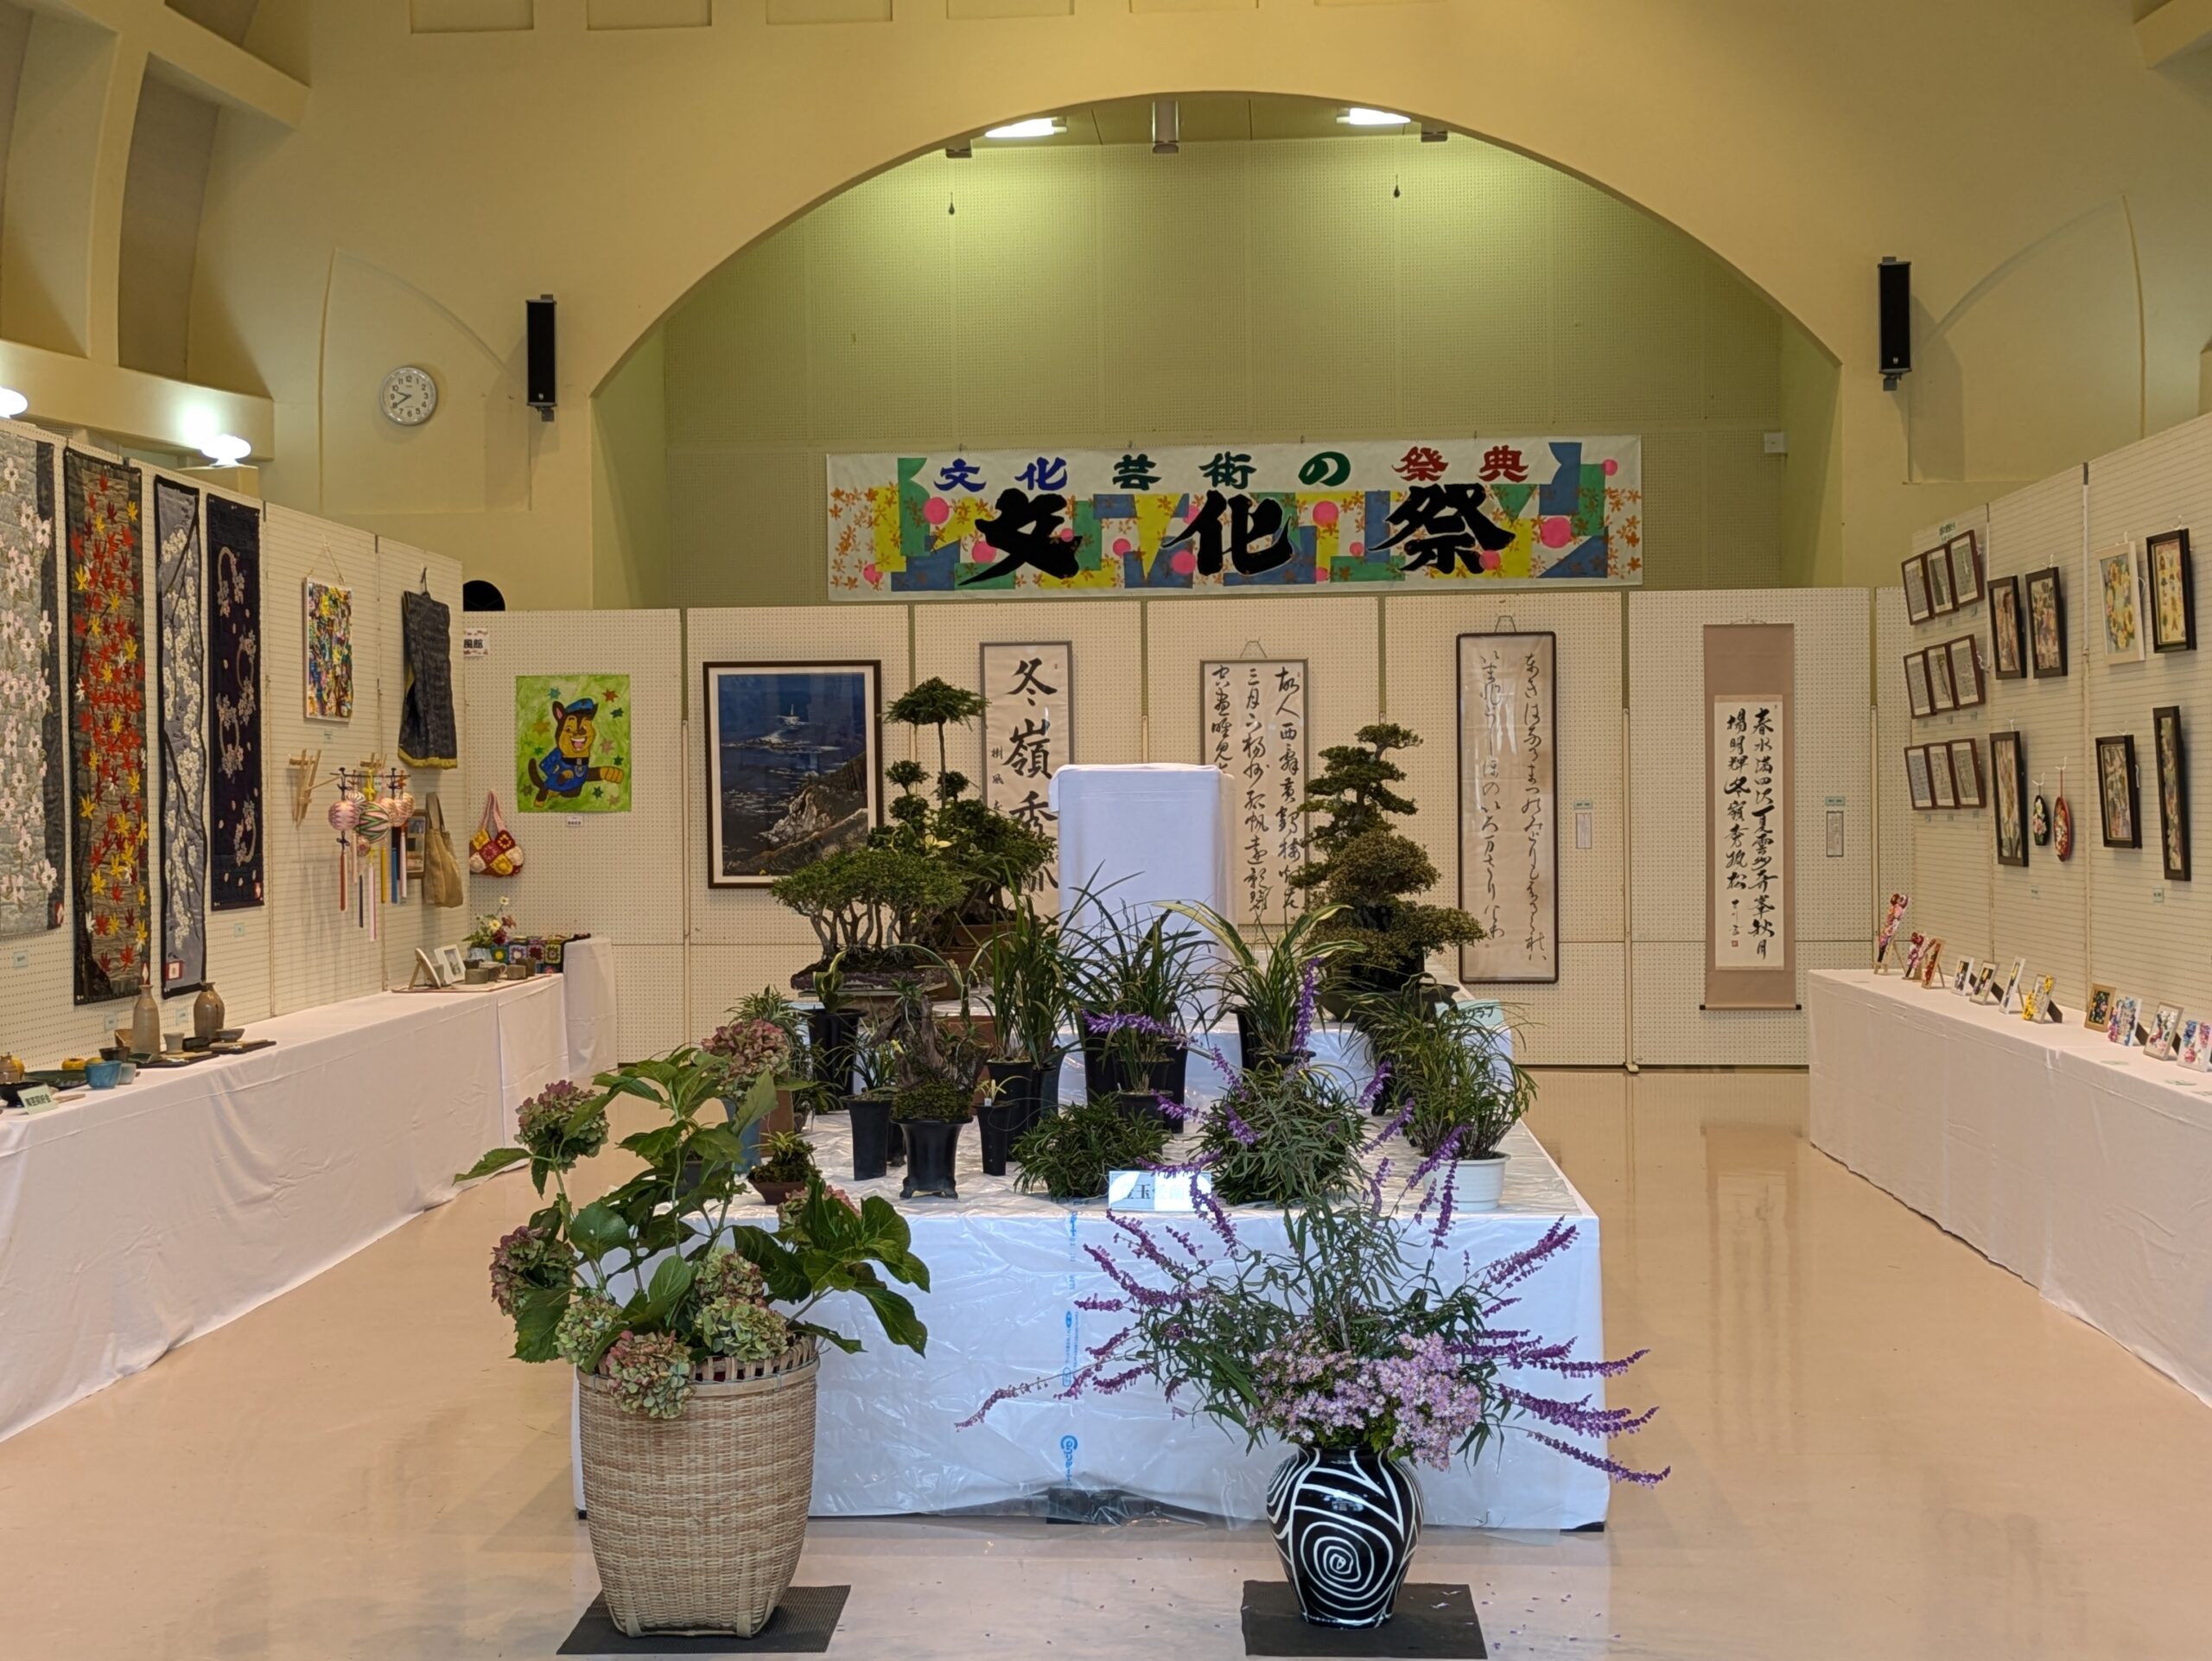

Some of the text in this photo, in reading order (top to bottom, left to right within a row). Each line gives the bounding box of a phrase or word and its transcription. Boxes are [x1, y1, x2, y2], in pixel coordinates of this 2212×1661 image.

[933, 445, 1529, 493] 文化芸術の祭典
[957, 482, 1516, 586] 文化祭
